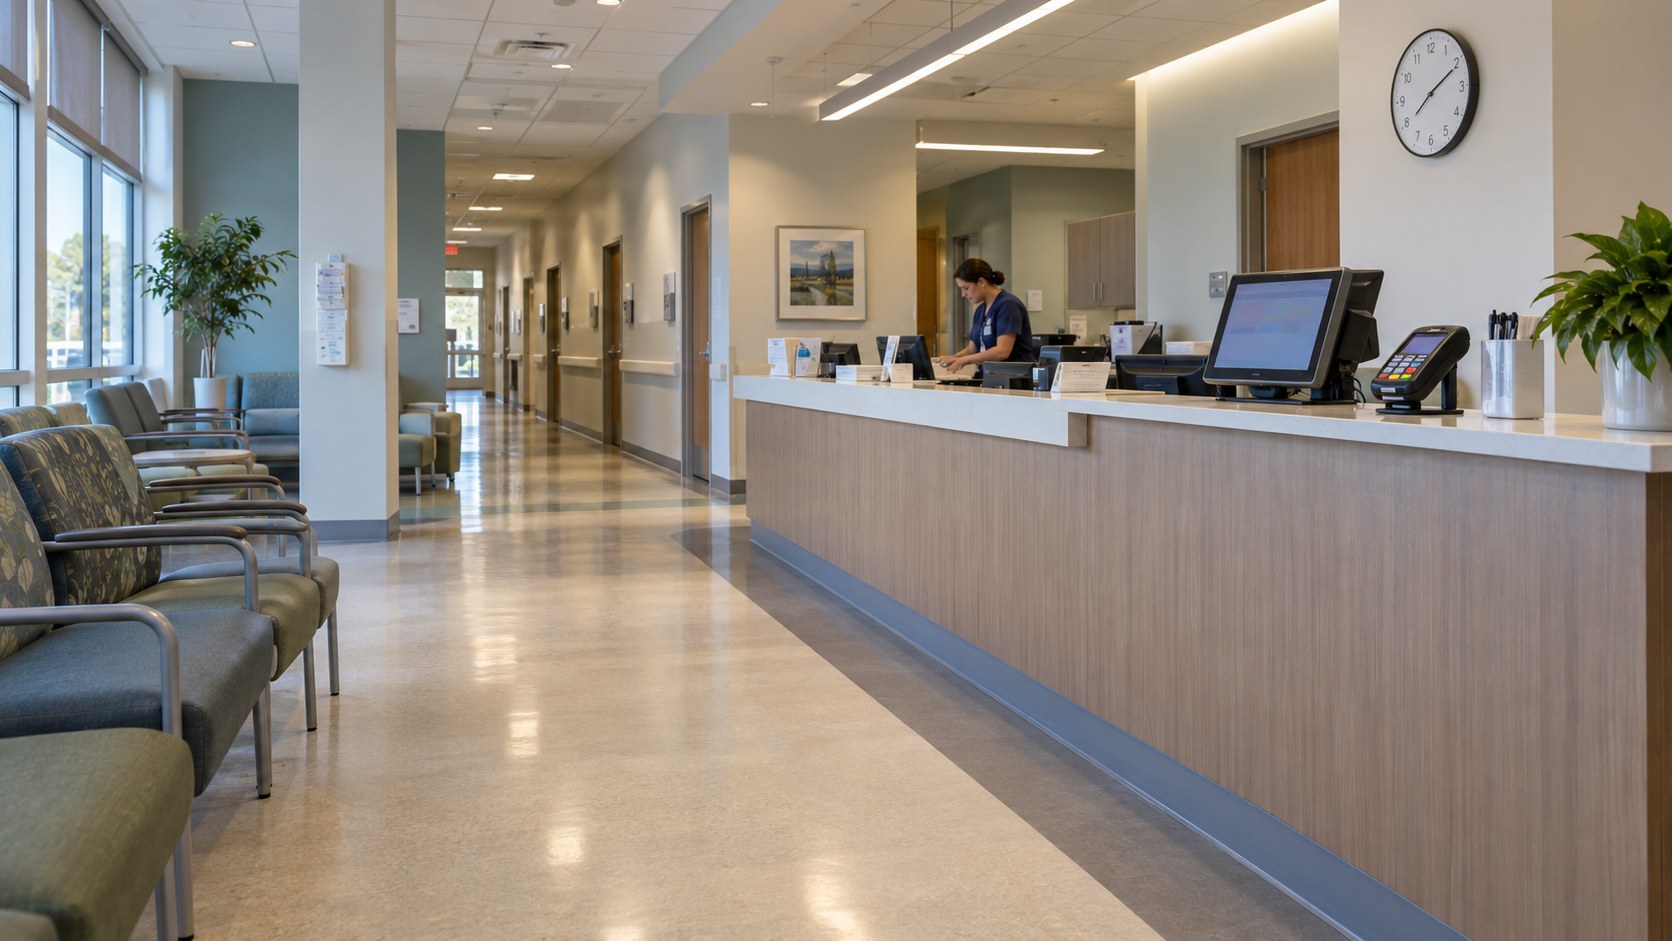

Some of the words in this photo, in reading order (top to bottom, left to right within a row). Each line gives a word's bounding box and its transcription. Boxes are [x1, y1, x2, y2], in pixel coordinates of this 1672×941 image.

[1427, 42, 1435, 54] 12
[1414, 53, 1420, 64] 11
[1454, 57, 1459, 69] 2
[1404, 72, 1411, 84] 10
[1459, 80, 1465, 92] 3
[1400, 96, 1405, 107] 9
[1454, 106, 1459, 117] 4
[1404, 117, 1410, 128] 8
[1415, 131, 1421, 141] 7
[1443, 125, 1448, 136] 5
[1428, 135, 1433, 145] 6
